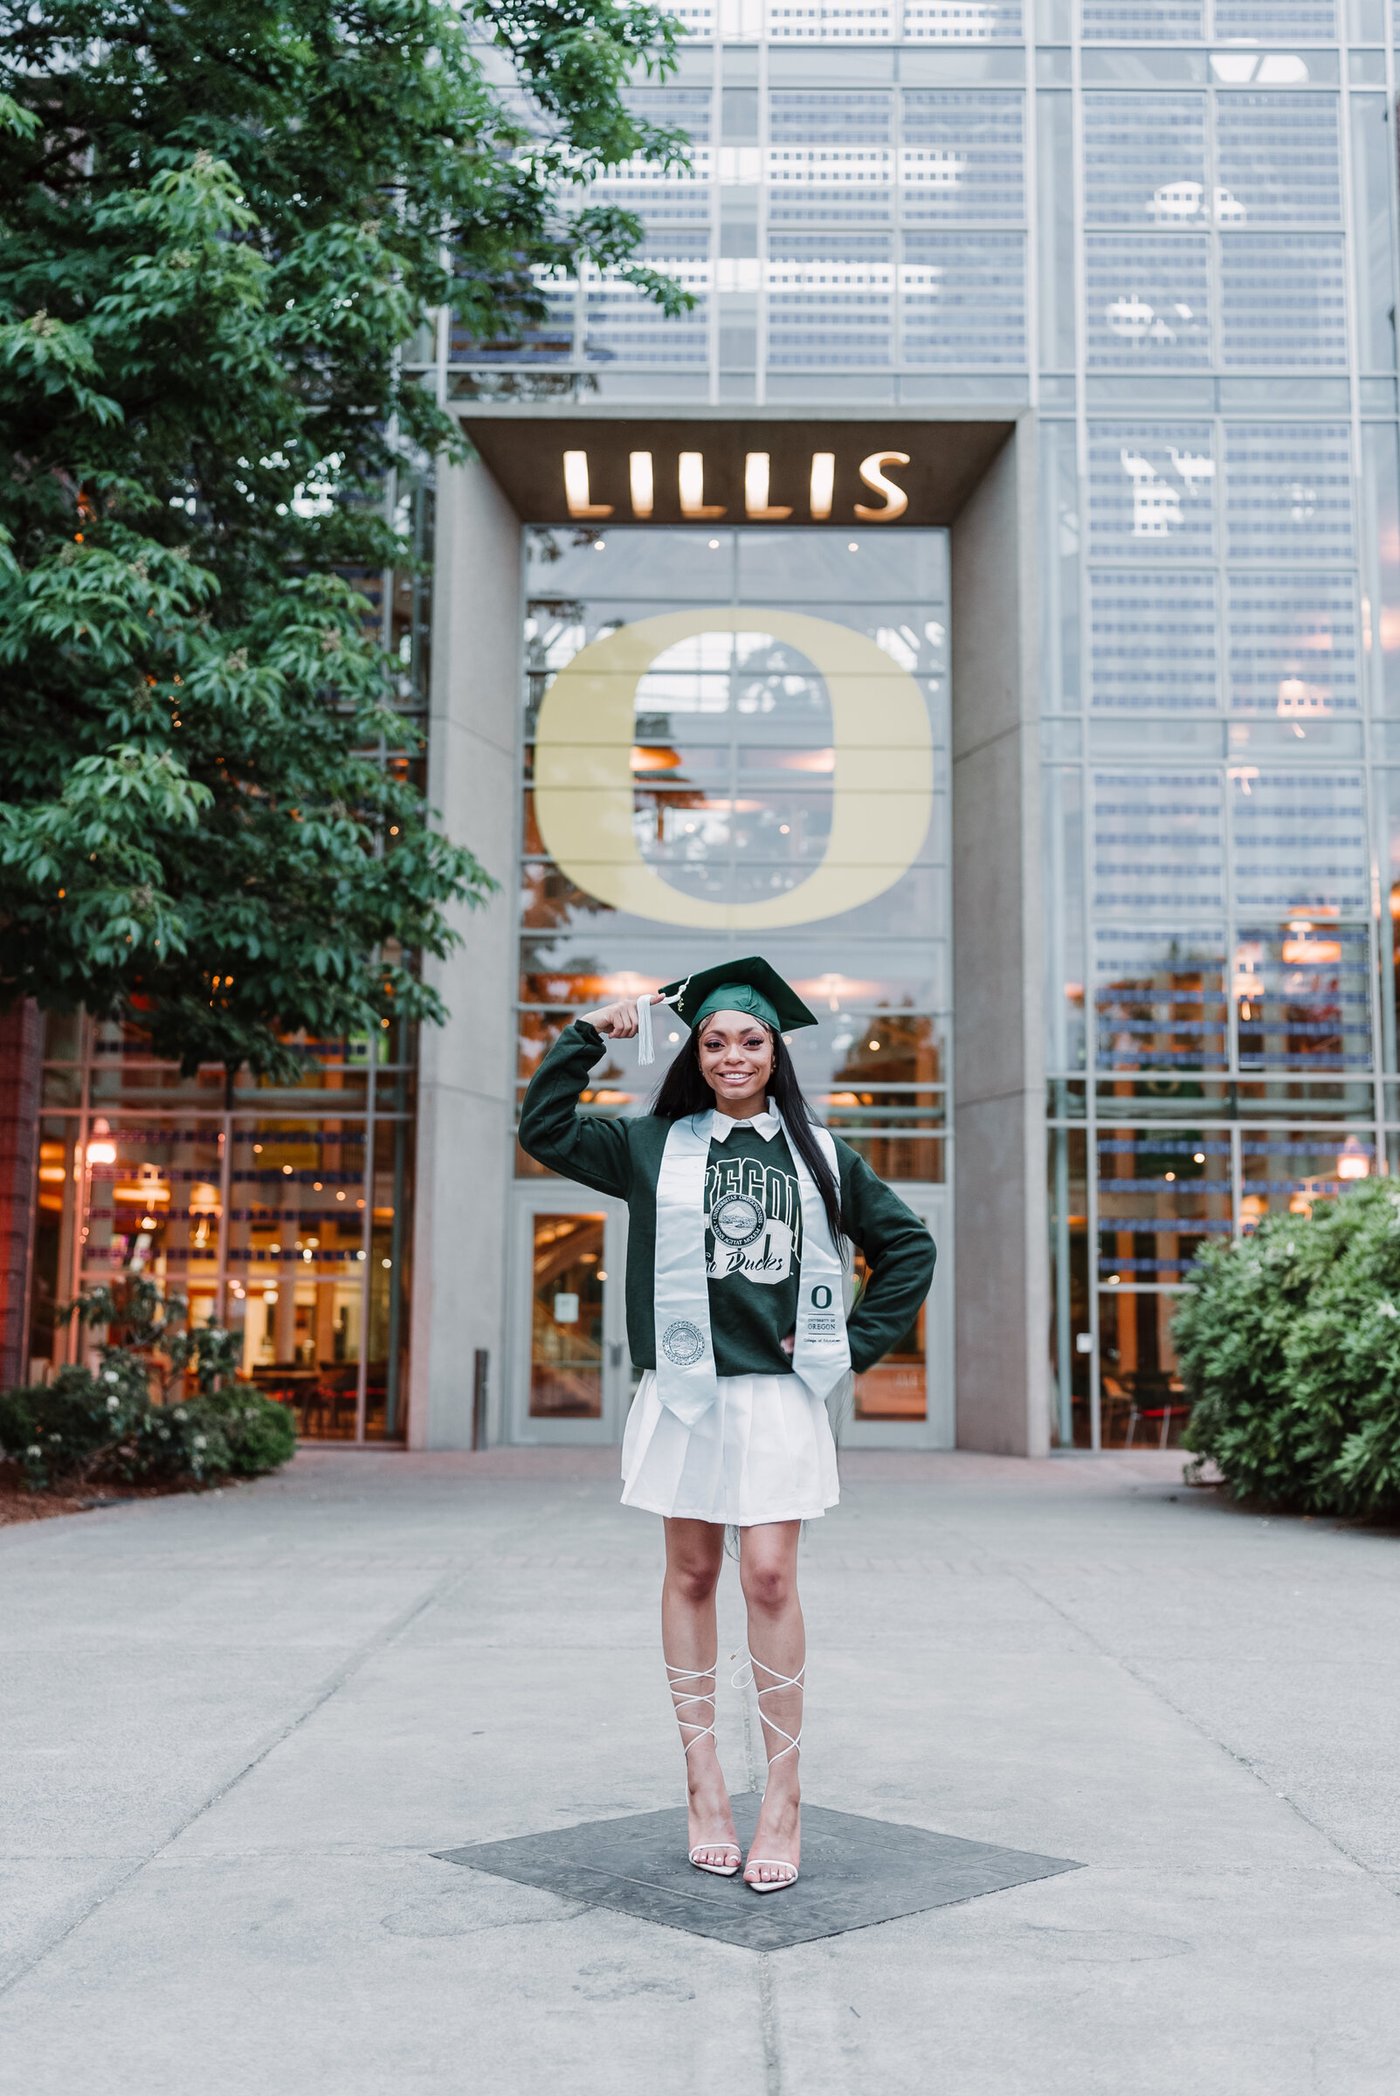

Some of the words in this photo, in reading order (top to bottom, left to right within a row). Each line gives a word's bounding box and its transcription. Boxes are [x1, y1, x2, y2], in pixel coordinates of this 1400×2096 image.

[563, 450, 911, 520] LILLIS
[534, 608, 934, 931] O
[726, 1251, 783, 1272] Ducks
[811, 1285, 832, 1309] O
